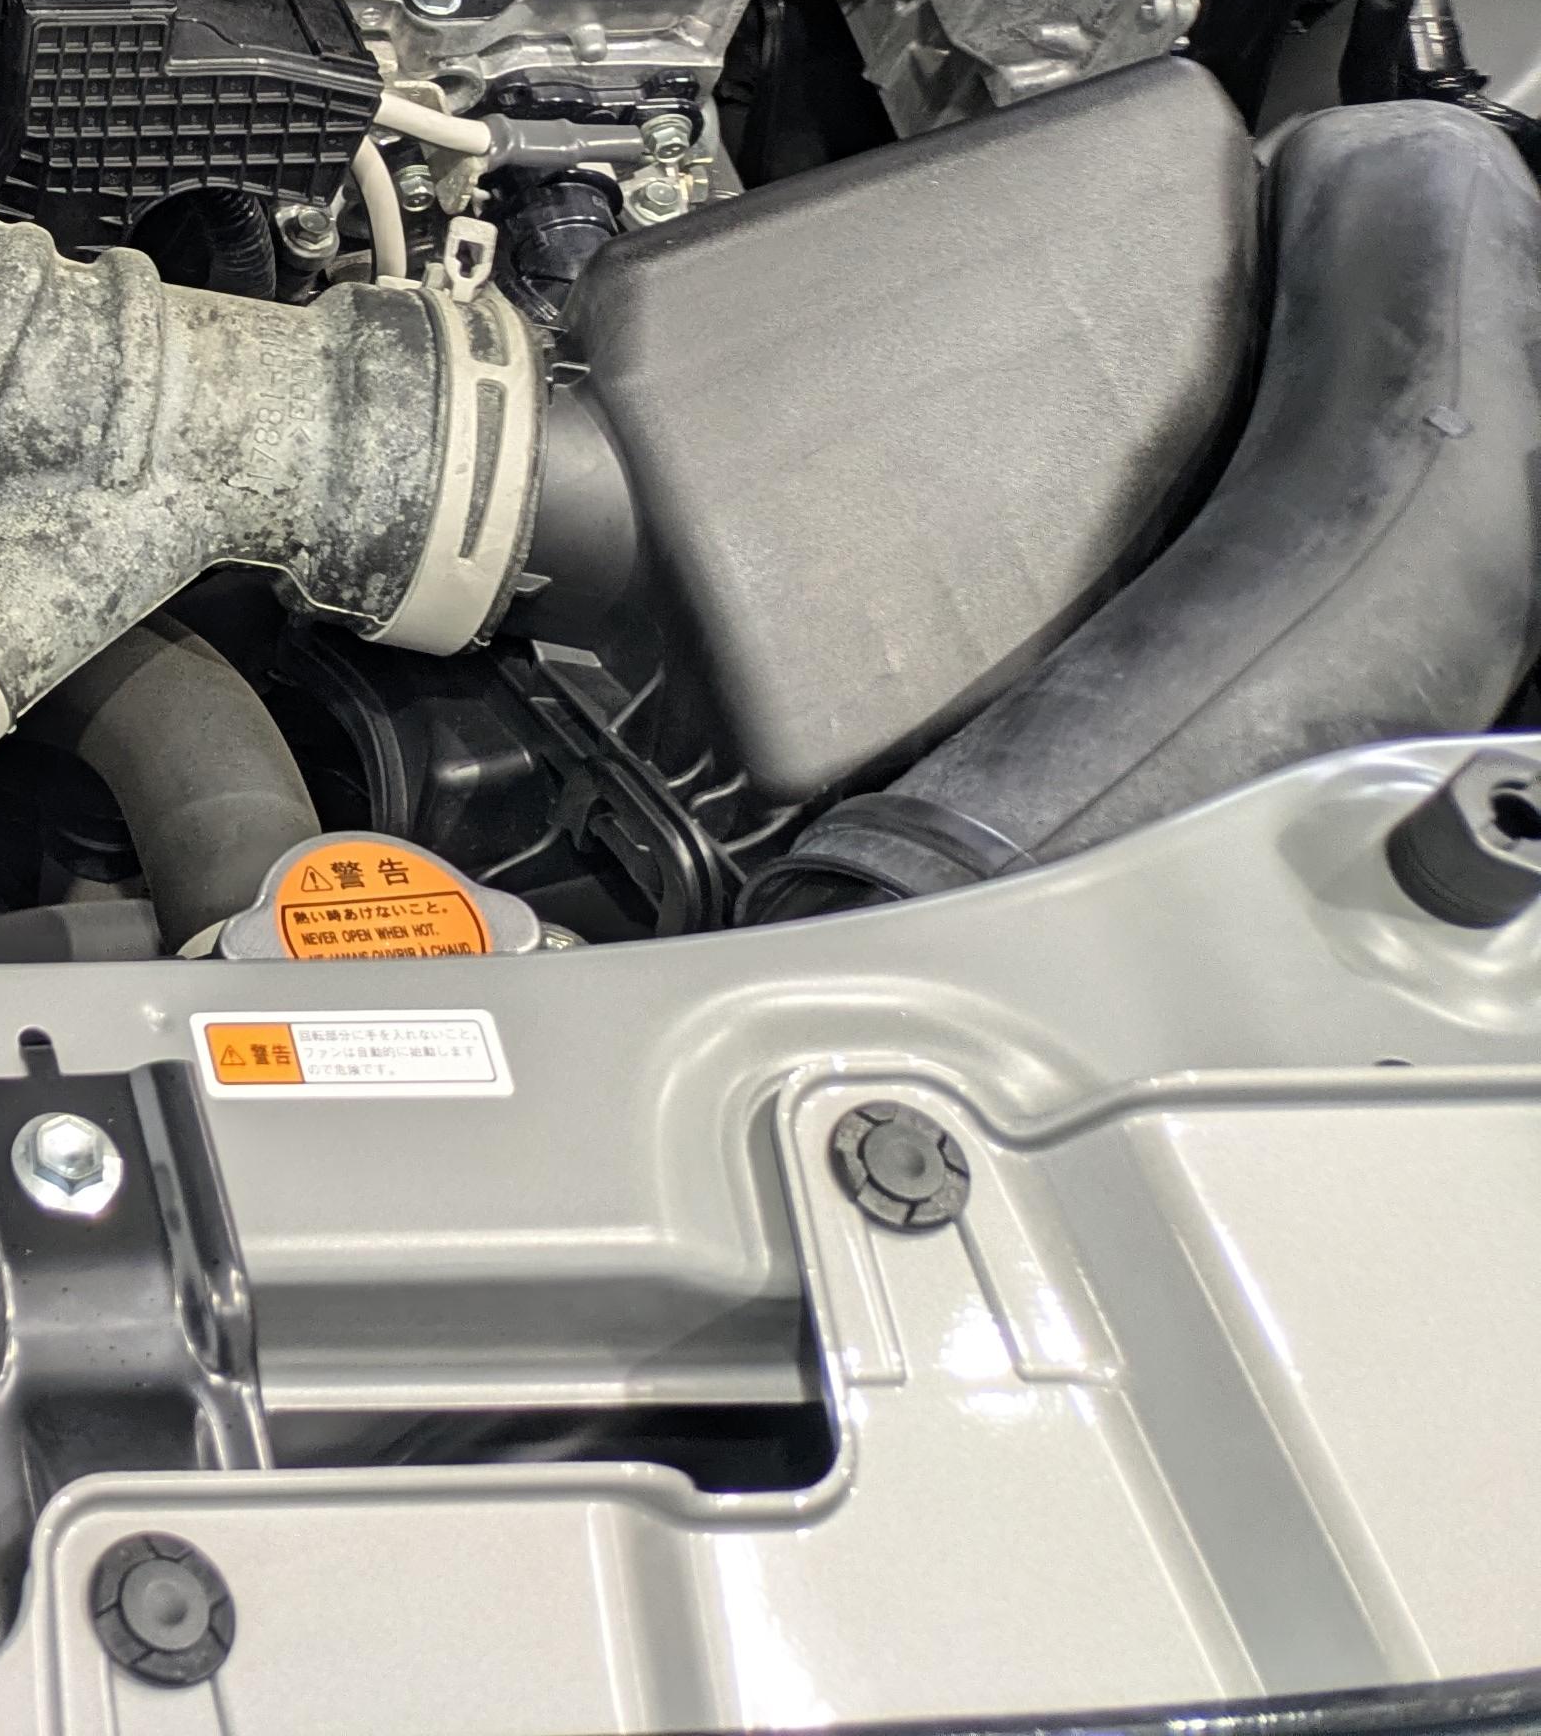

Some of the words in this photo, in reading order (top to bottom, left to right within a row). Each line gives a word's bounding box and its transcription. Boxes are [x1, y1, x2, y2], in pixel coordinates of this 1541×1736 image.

[329, 857, 411, 889] 警告
[301, 931, 339, 946] NEVER
[343, 929, 373, 943] OPEN
[377, 927, 408, 942] WHEN
[412, 924, 440, 939] HOT.
[249, 1042, 293, 1067] 警告
